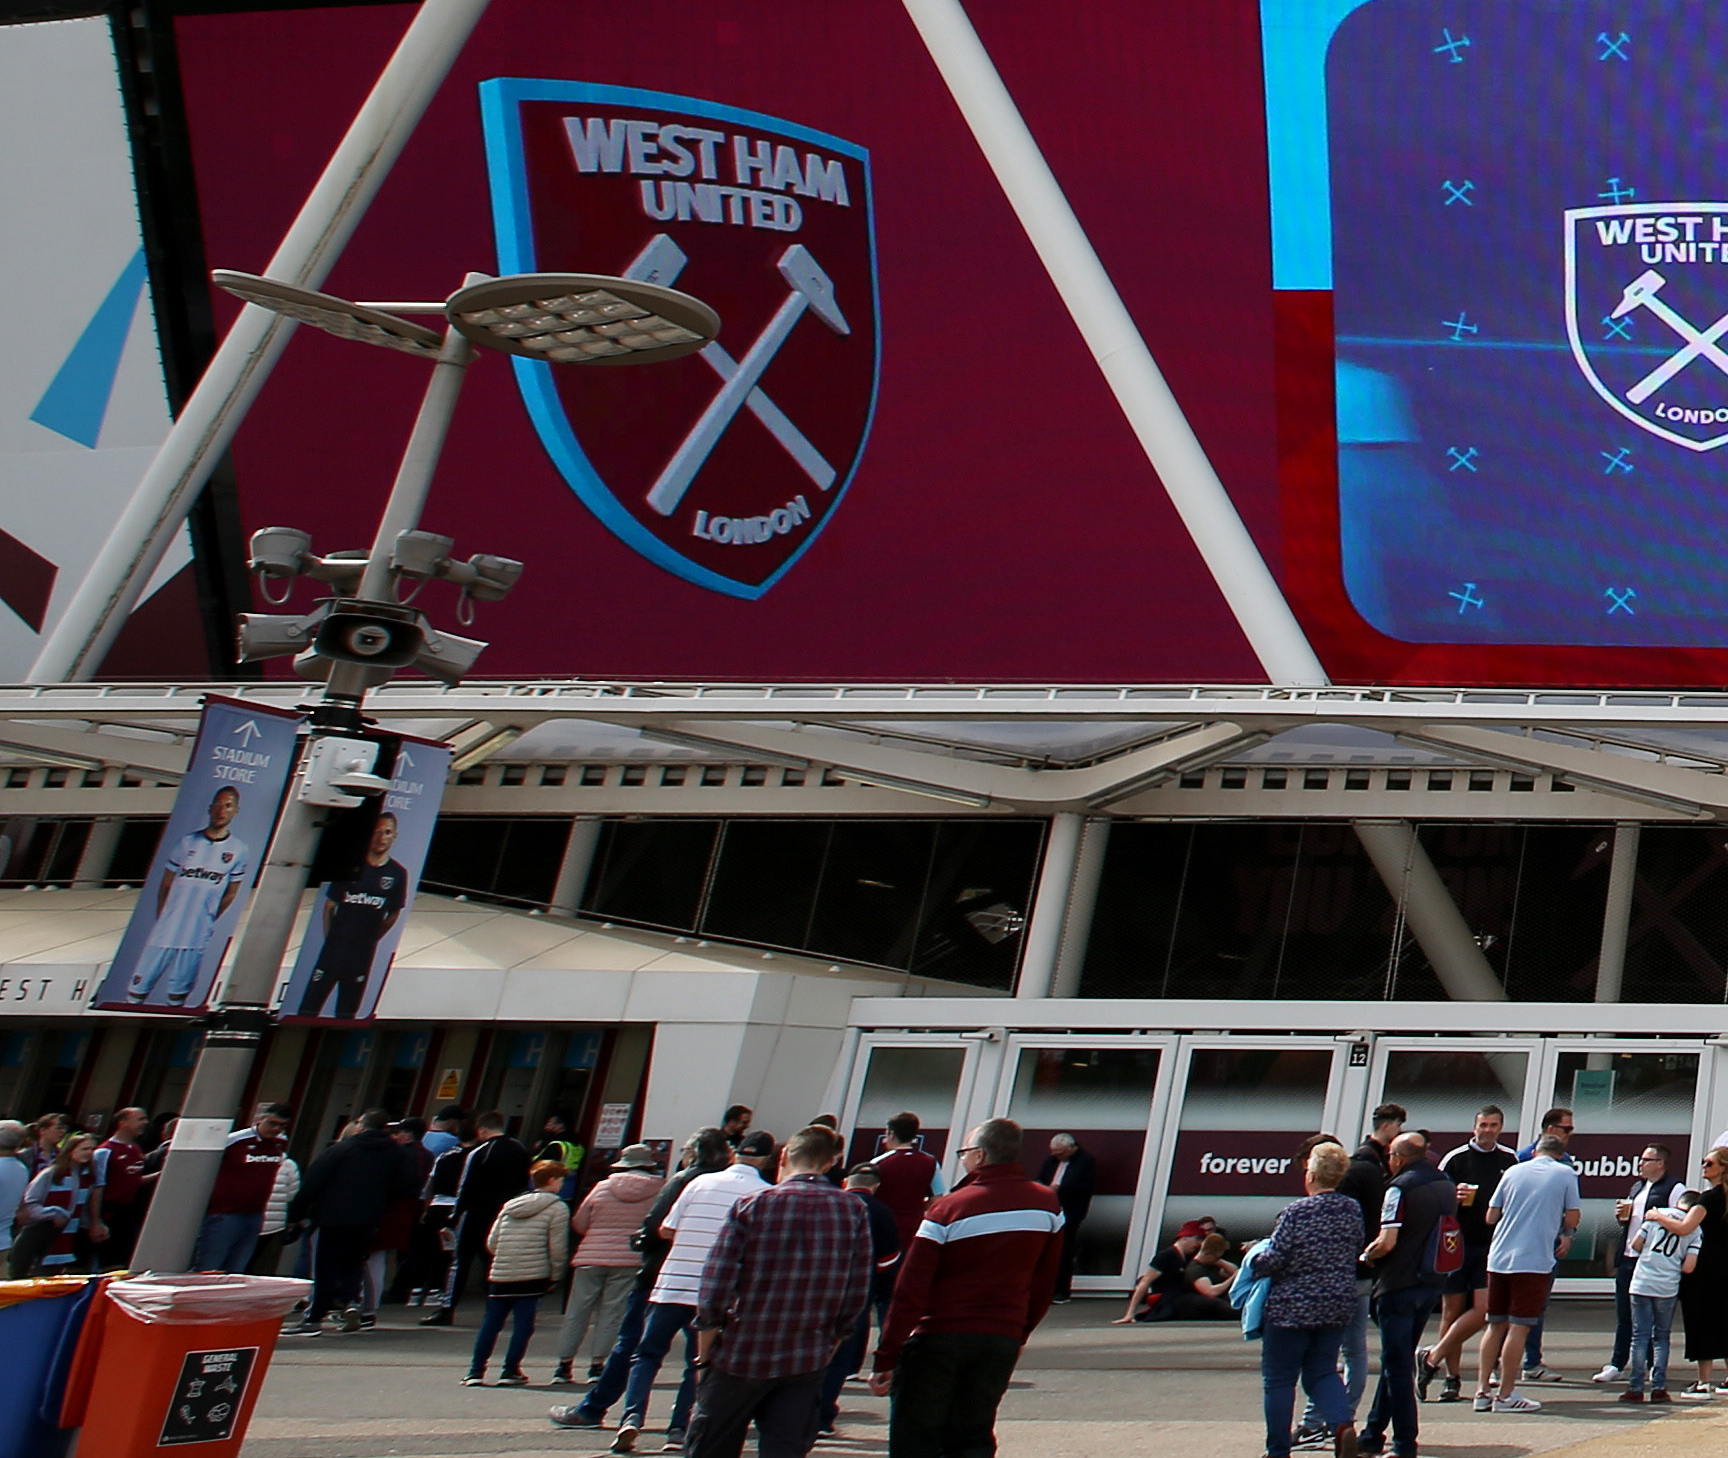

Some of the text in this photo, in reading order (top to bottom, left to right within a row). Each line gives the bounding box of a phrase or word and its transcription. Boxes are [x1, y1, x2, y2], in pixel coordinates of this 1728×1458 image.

[563, 116, 851, 206] WEST HAM
[641, 179, 803, 232] UNITED
[1595, 215, 1703, 246] WEST
[692, 494, 811, 546] LONDON
[211, 746, 271, 769] STADIUM
[212, 763, 258, 784] STORE
[390, 780, 425, 796] DIUM
[385, 793, 412, 810] ORE
[179, 865, 225, 885] betway
[344, 890, 387, 908] betway
[1351, 1053, 1367, 1064] 12
[246, 1153, 284, 1164] betwa
[1199, 1152, 1292, 1176] forever
[1570, 1154, 1644, 1178] bubbl
[1651, 1226, 1681, 1258] 20
